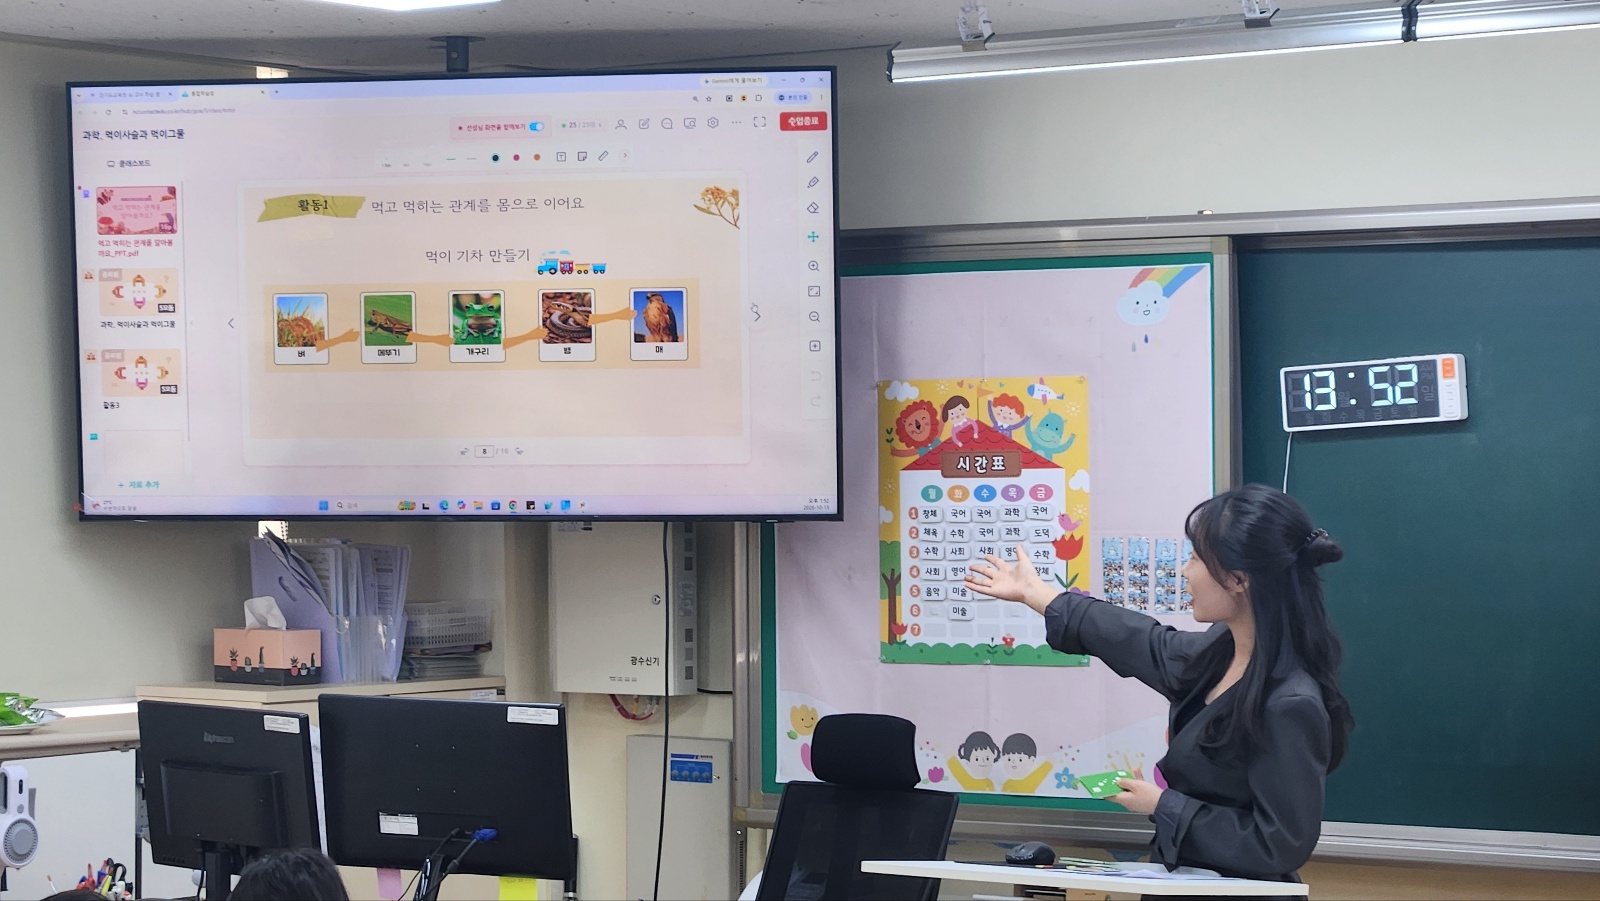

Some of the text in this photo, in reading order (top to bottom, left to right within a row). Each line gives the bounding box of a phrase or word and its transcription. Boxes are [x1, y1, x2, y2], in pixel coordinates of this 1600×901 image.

[788, 117, 819, 127] 수업종료
[82, 128, 185, 140] 과학. 먹이사슬과 먹이그물
[119, 159, 151, 168] 클래스보드
[298, 199, 329, 212] 활동1
[372, 197, 585, 215] 먹고 먹히는 관계를 몸으로 이어요
[112, 239, 132, 247] 먹히는
[134, 239, 152, 247] 관계를
[154, 239, 173, 247] 알아볼
[426, 248, 530, 263] 먹이 기차 만들기
[117, 320, 149, 328] 먹이사슬과
[151, 320, 176, 328] 먹이그물
[297, 350, 306, 358] 벼
[377, 348, 401, 357] 메뚜기
[466, 347, 490, 356] 개구리
[563, 346, 572, 355] 뱀
[655, 345, 664, 354] 매
[1303, 363, 1419, 411] 13:52
[103, 401, 120, 409] 활동3
[957, 456, 1006, 474] 시간표
[145, 480, 160, 489] 추가
[927, 487, 1047, 499] 월 화 수 목 금
[922, 509, 937, 519] 창체
[950, 509, 966, 518] 국어
[976, 509, 992, 518] 국어
[1004, 508, 1020, 517] 과학
[1031, 506, 1048, 515] 국어
[911, 528, 1050, 539] 2 체육 수학 국어 과학 도덕
[912, 548, 917, 557] 3
[924, 546, 939, 556] 수학
[950, 547, 965, 556] 사회
[979, 546, 994, 555] 사회
[1033, 550, 1050, 560] 수학
[912, 567, 918, 577] 4
[925, 567, 940, 576] 사회
[951, 566, 966, 577] 영어
[912, 586, 967, 597] 5 음악 미술
[912, 606, 967, 616] 6 미술
[913, 625, 918, 634] 7
[630, 656, 660, 666] 광수신기
